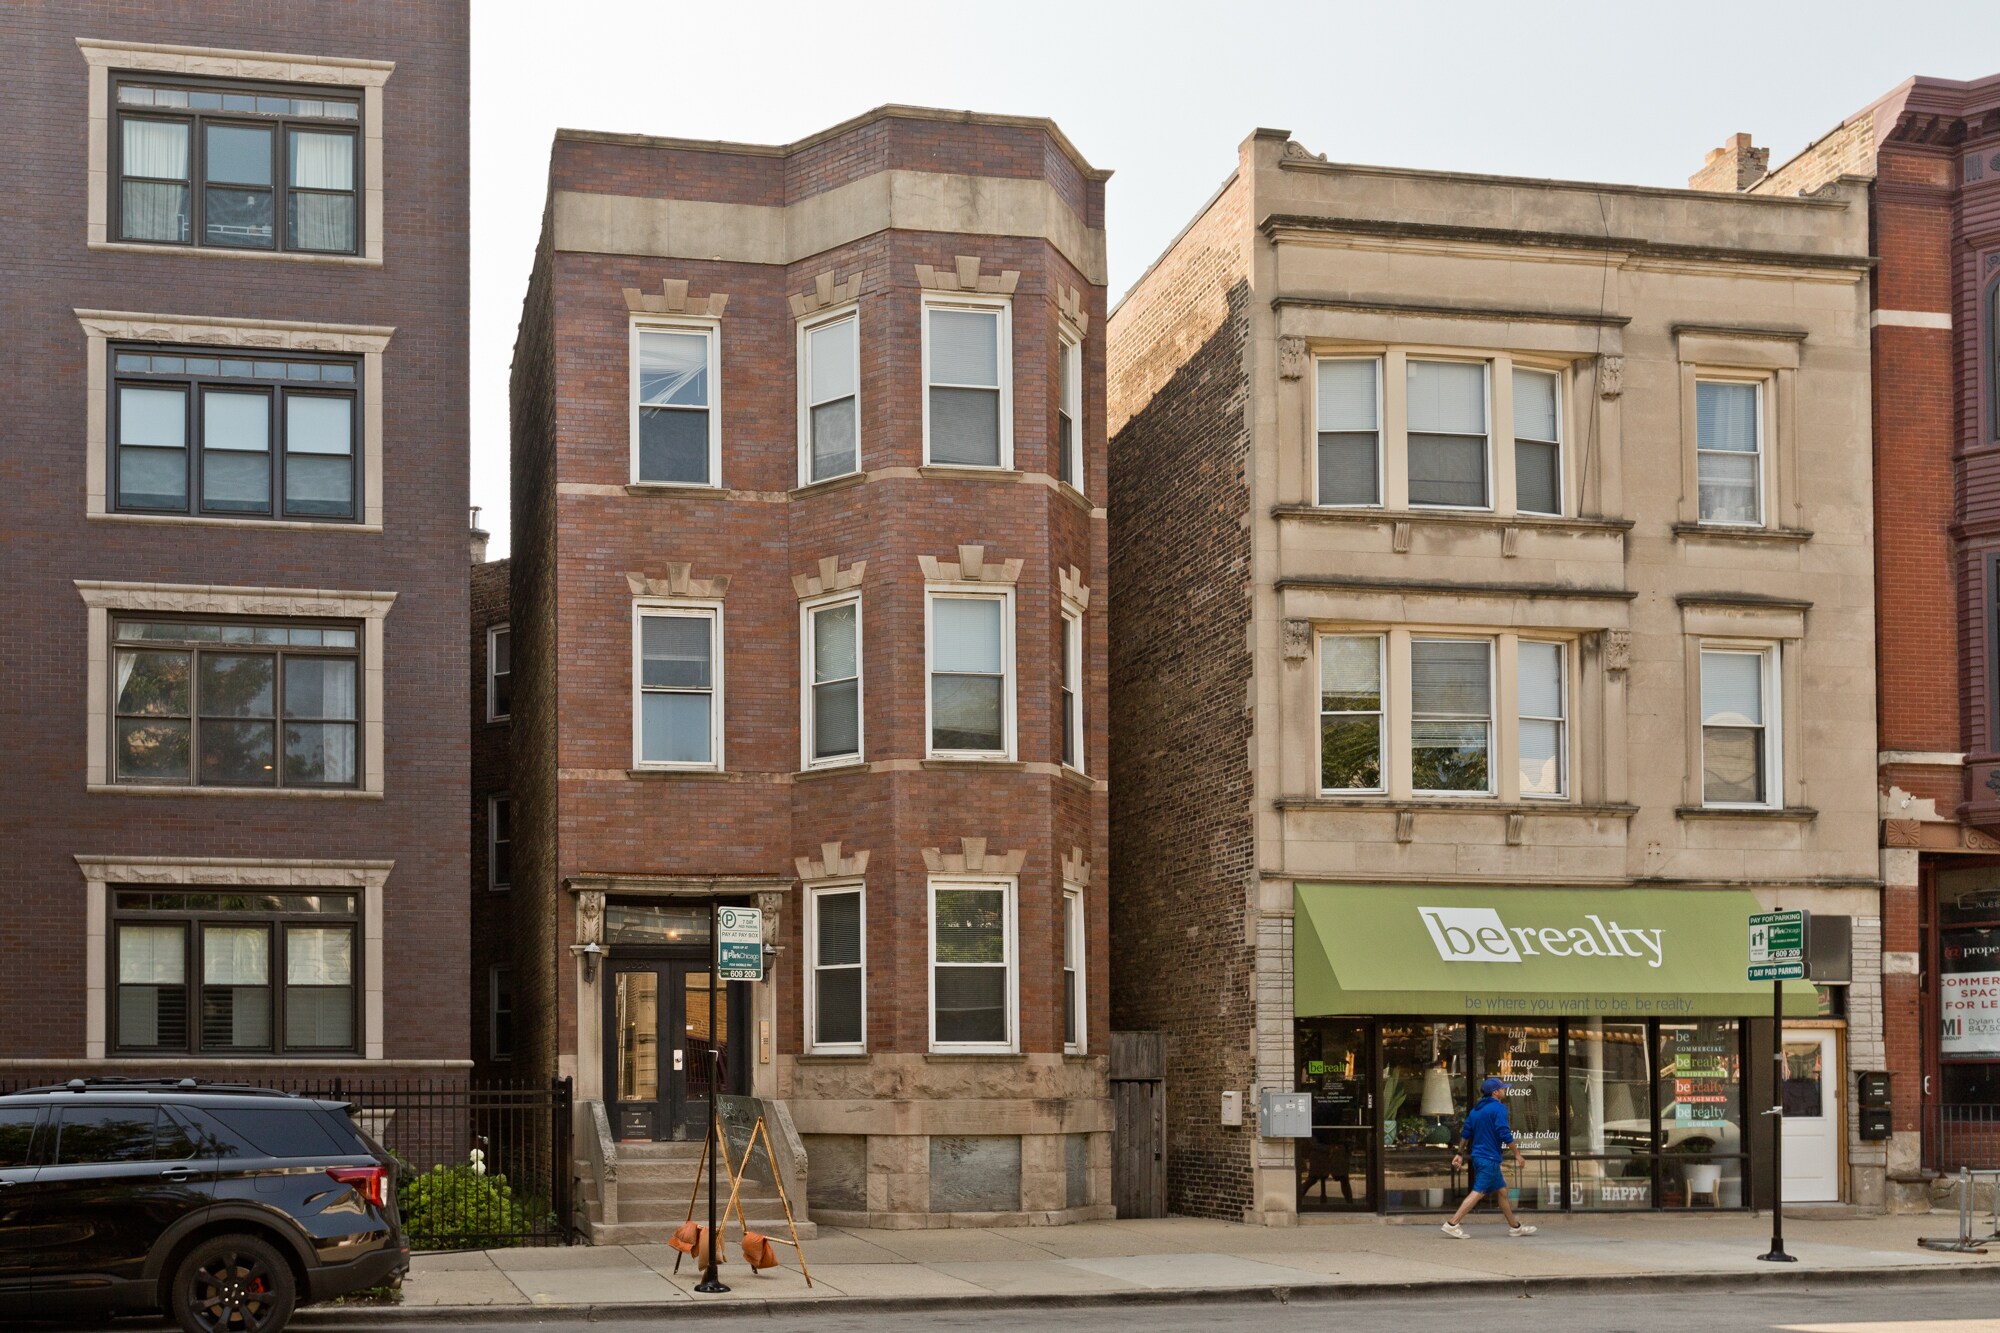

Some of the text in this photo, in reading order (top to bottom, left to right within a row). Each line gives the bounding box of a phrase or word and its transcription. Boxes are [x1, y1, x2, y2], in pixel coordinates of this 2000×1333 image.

[729, 952, 759, 960] ParkChicago
[1778, 966, 1801, 975] PARKING
[1466, 995, 1694, 1012] be where you want to be. be realty.
[1946, 1001, 1975, 1010] FOR
[1508, 1028, 1527, 1040] buy
[1676, 1030, 1689, 1042] be
[1510, 1044, 1526, 1053] sell
[1498, 1059, 1539, 1069] manage
[1676, 1054, 1723, 1069] be realt
[1311, 1062, 1348, 1073] be realt
[1503, 1072, 1533, 1081] invest
[1506, 1087, 1531, 1096] lease
[1676, 1080, 1725, 1093] be realty
[1677, 1105, 1725, 1120] be realty
[1511, 1130, 1521, 1139] ith
[1536, 1130, 1560, 1140] today
[1601, 1187, 1647, 1201] HAPPY
